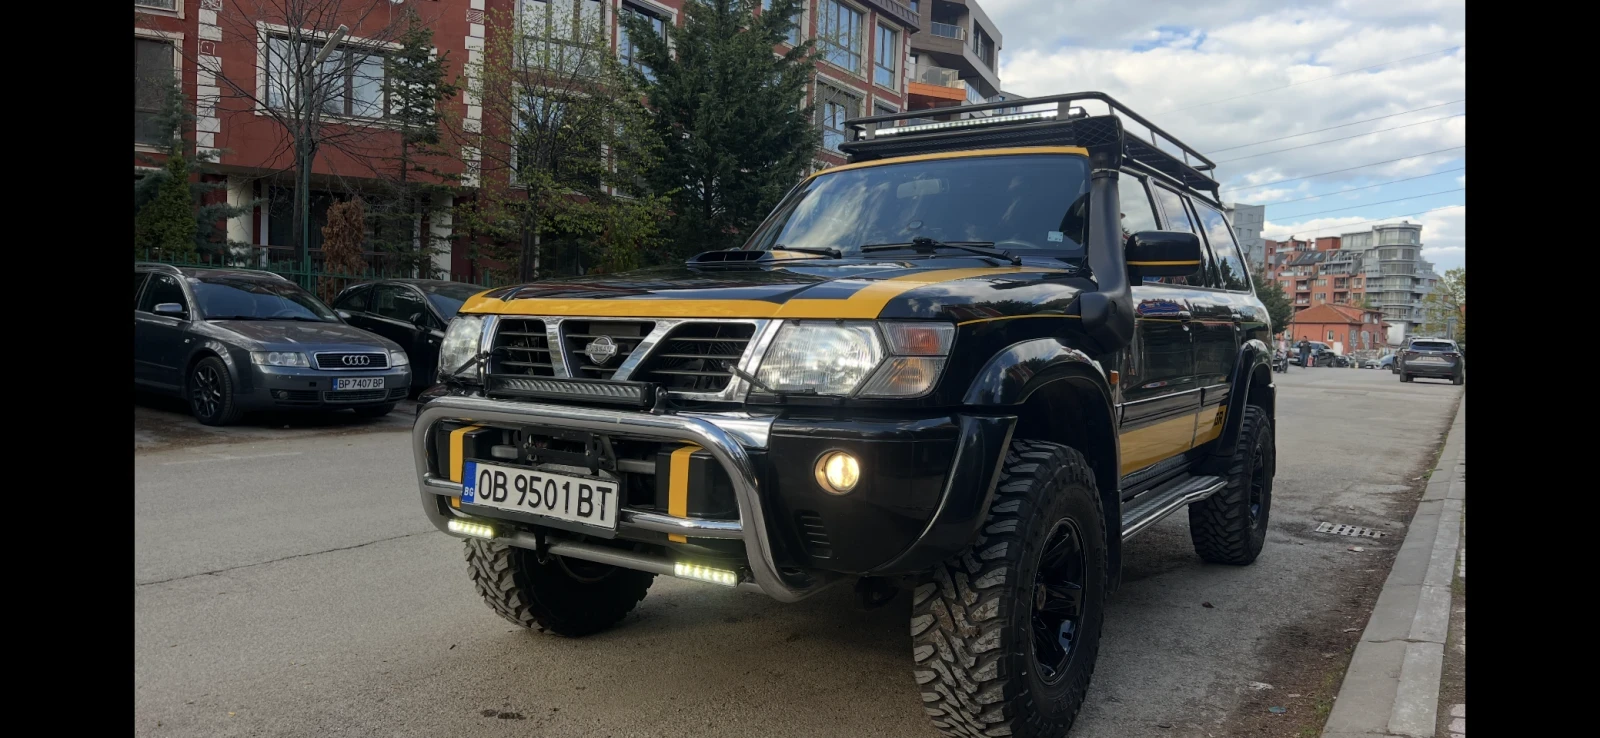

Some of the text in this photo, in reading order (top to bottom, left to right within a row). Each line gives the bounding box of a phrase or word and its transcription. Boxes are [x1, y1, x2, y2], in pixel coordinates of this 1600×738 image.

[339, 379, 351, 389] BP
[352, 379, 372, 389] 7407
[373, 378, 383, 388] BP
[464, 486, 474, 497] BG
[478, 469, 613, 521] OB 9501 BT
